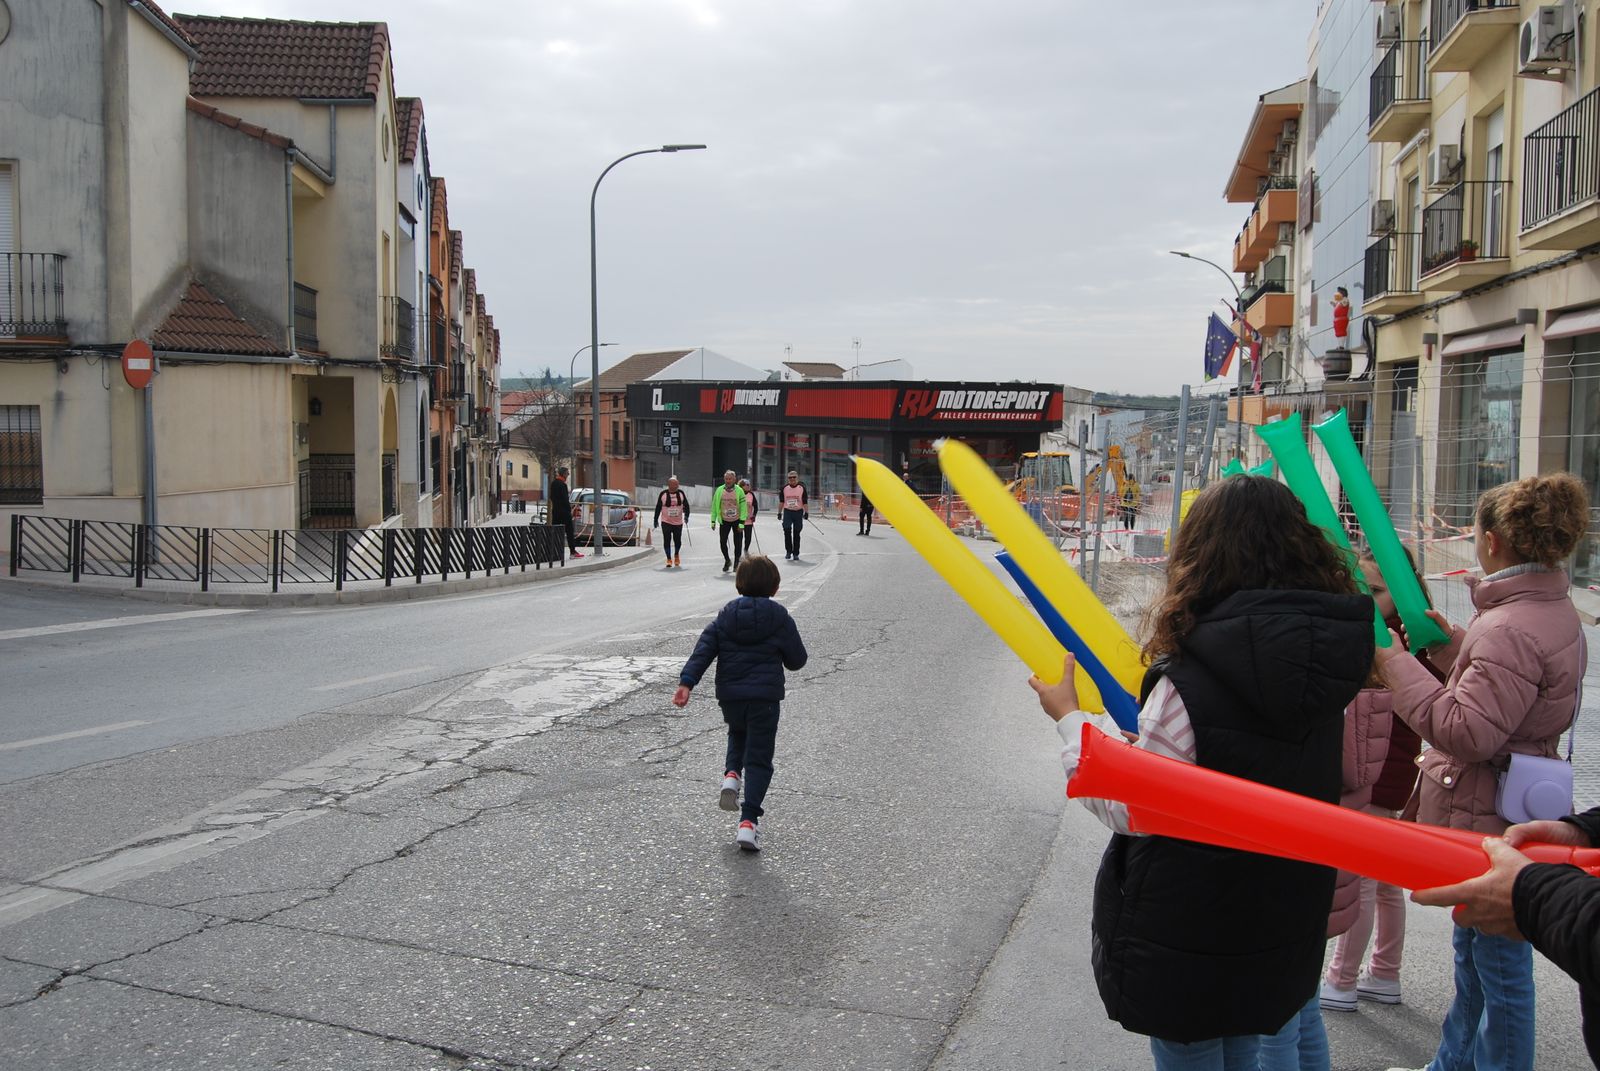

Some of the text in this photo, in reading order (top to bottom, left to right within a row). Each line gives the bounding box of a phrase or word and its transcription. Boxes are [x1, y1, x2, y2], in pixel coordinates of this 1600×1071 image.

[936, 390, 1049, 410] MOTORSPORT
[939, 411, 1038, 420] TALLER ELECTROMECANICO
